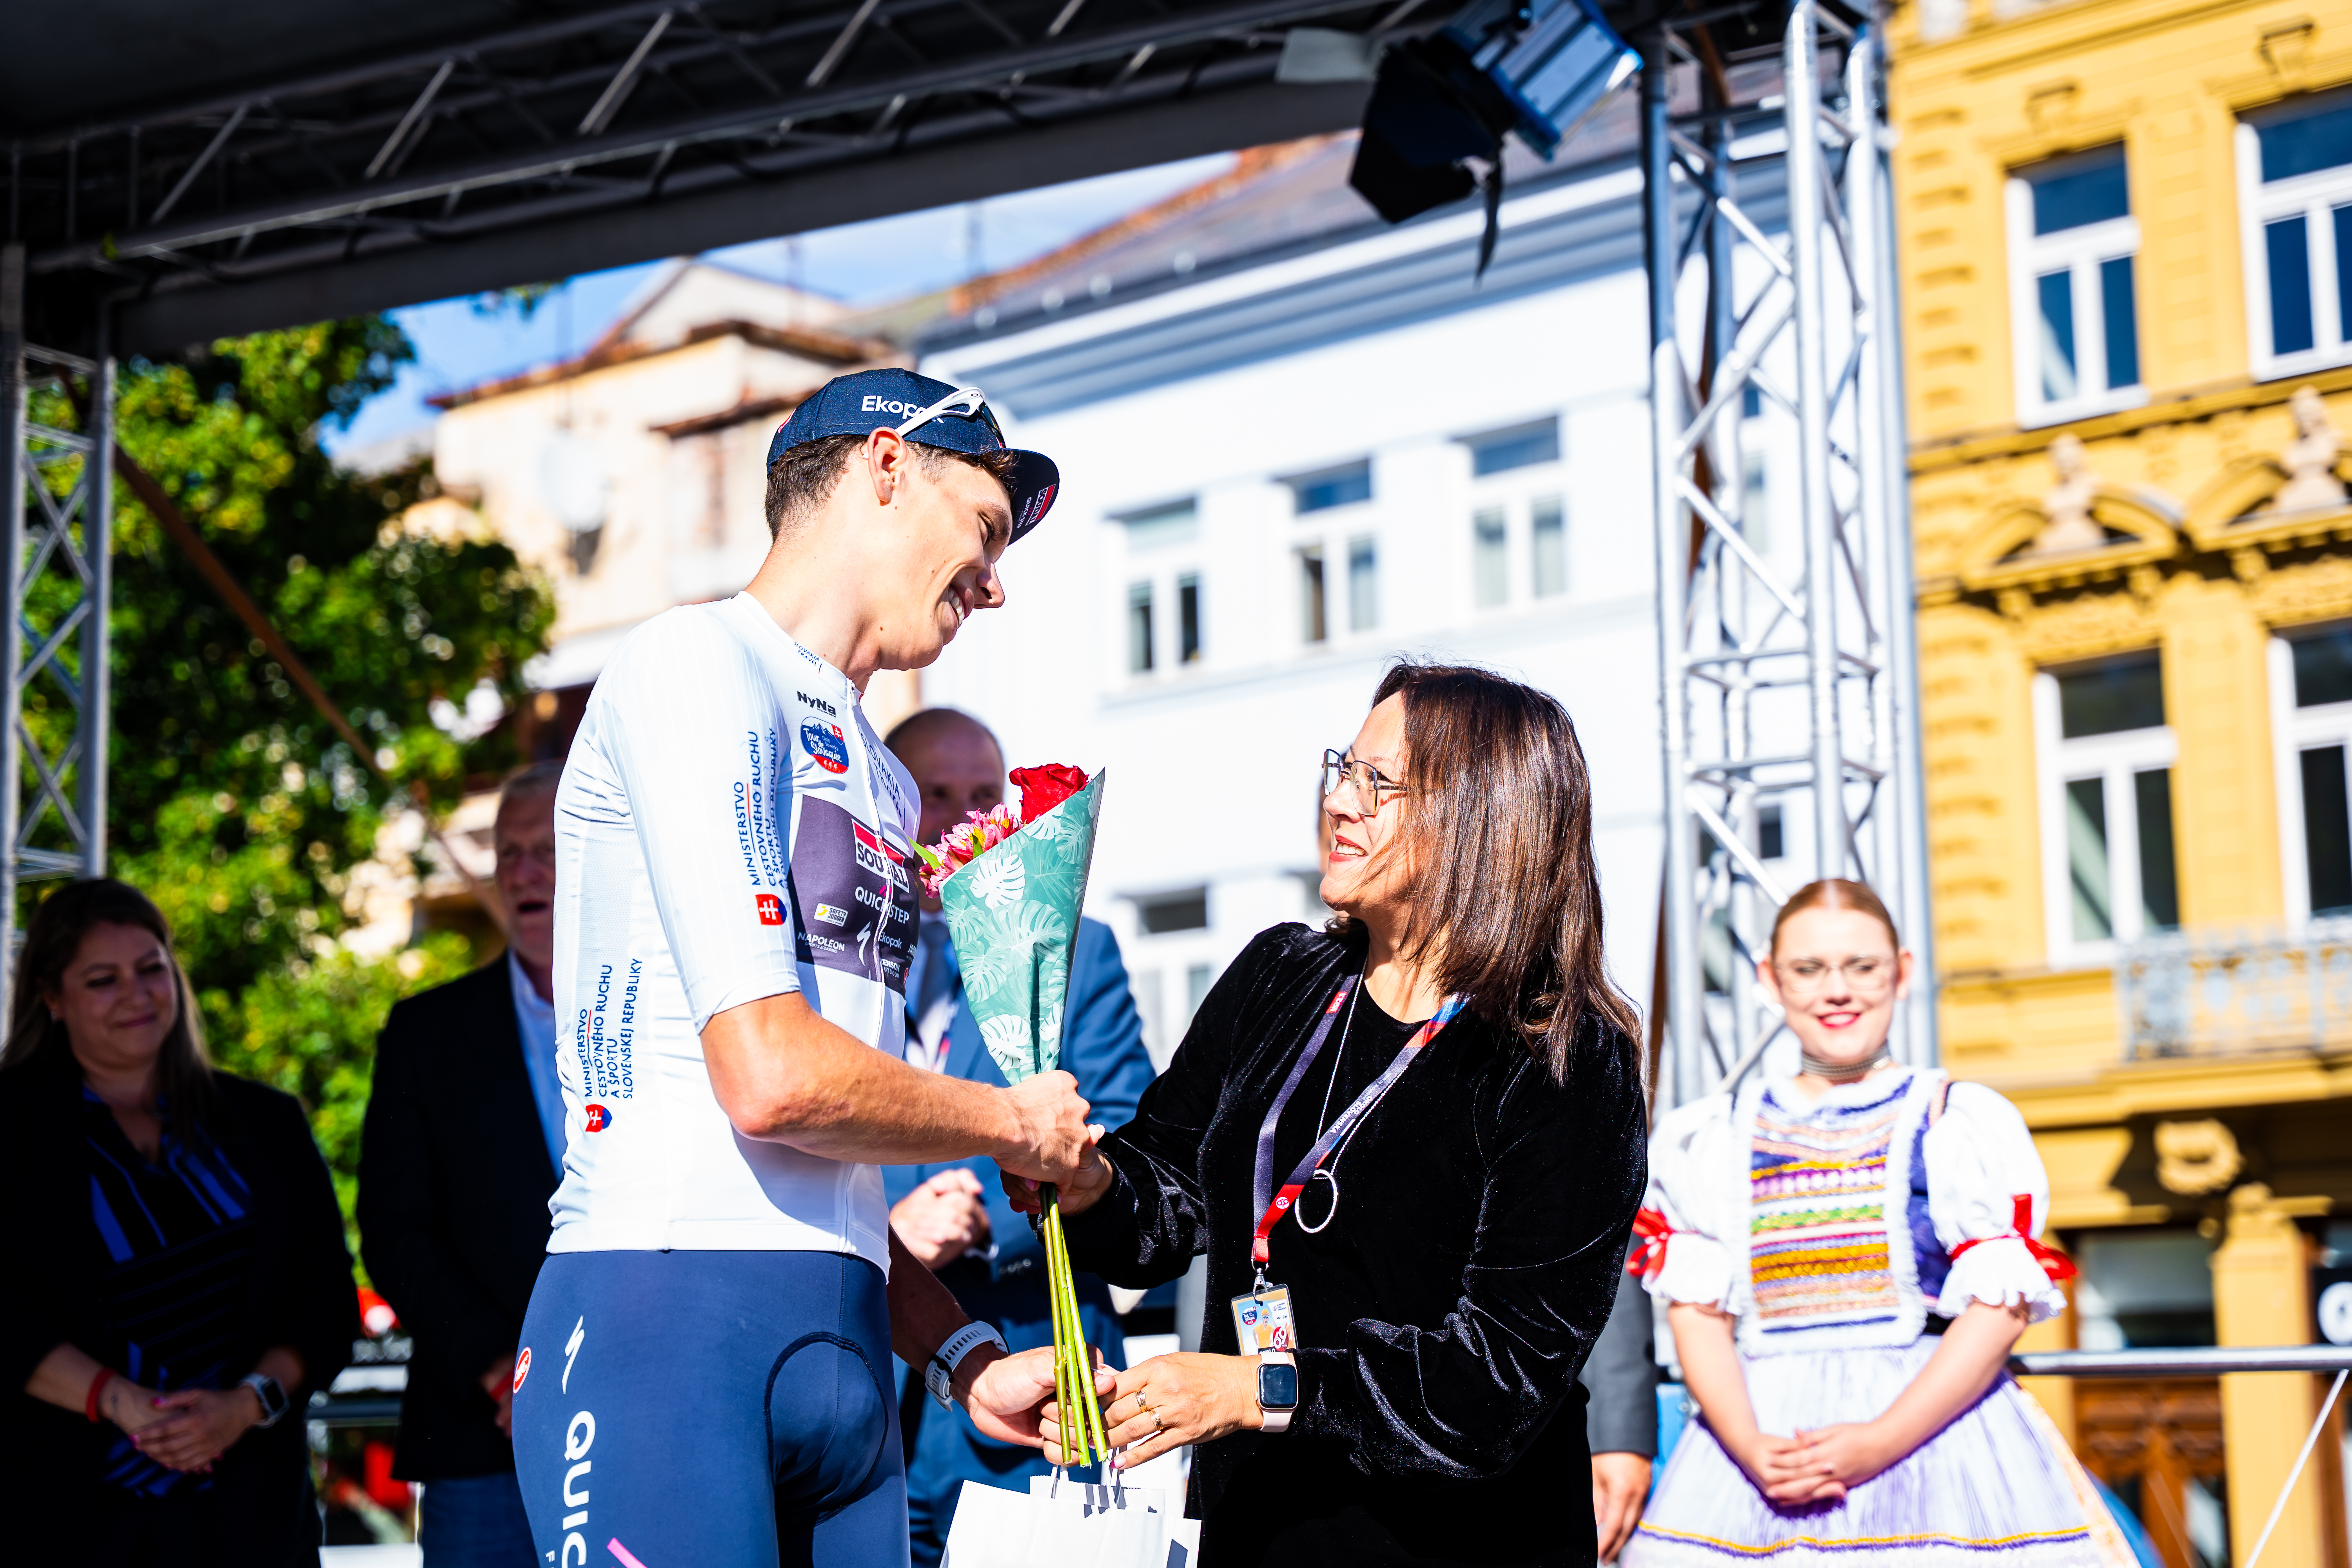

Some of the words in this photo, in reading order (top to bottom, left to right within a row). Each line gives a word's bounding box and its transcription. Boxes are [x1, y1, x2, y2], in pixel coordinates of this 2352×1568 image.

[861, 395, 944, 424] Ekop
[794, 641, 819, 662] SLOVAKIA
[798, 649, 817, 666] TRAVEL
[797, 691, 836, 715] NyNa
[803, 728, 819, 742] Tour
[818, 740, 824, 749] de
[748, 731, 761, 786] RUCHU
[810, 741, 842, 763] Slovaquie
[861, 733, 900, 800] SLOVAKIA
[734, 782, 760, 885] MINISTERSTVO
[753, 791, 776, 886] CESTOVNÉHO
[764, 818, 780, 874] ŠPORTU
[778, 879, 784, 888] A
[828, 913, 844, 923] JOGGER
[829, 908, 846, 917] SAFETY
[797, 932, 845, 951] NAPOLEON
[880, 958, 900, 972] ENSON
[884, 967, 899, 978] UTDOOR
[595, 965, 612, 1011] RUCHU
[622, 958, 642, 1024] REPUBLIKY
[577, 1009, 592, 1097] MINISTERSTVO
[591, 1016, 607, 1097] CESTOVNÉHO
[607, 1038, 620, 1085] ŠPORTU
[621, 1028, 634, 1099] SLOVENSKEJ
[1330, 1101, 1362, 1134] SLOVENSKA
[1354, 1096, 1372, 1115] OKOLO
[1274, 1327, 1287, 1349] 69
